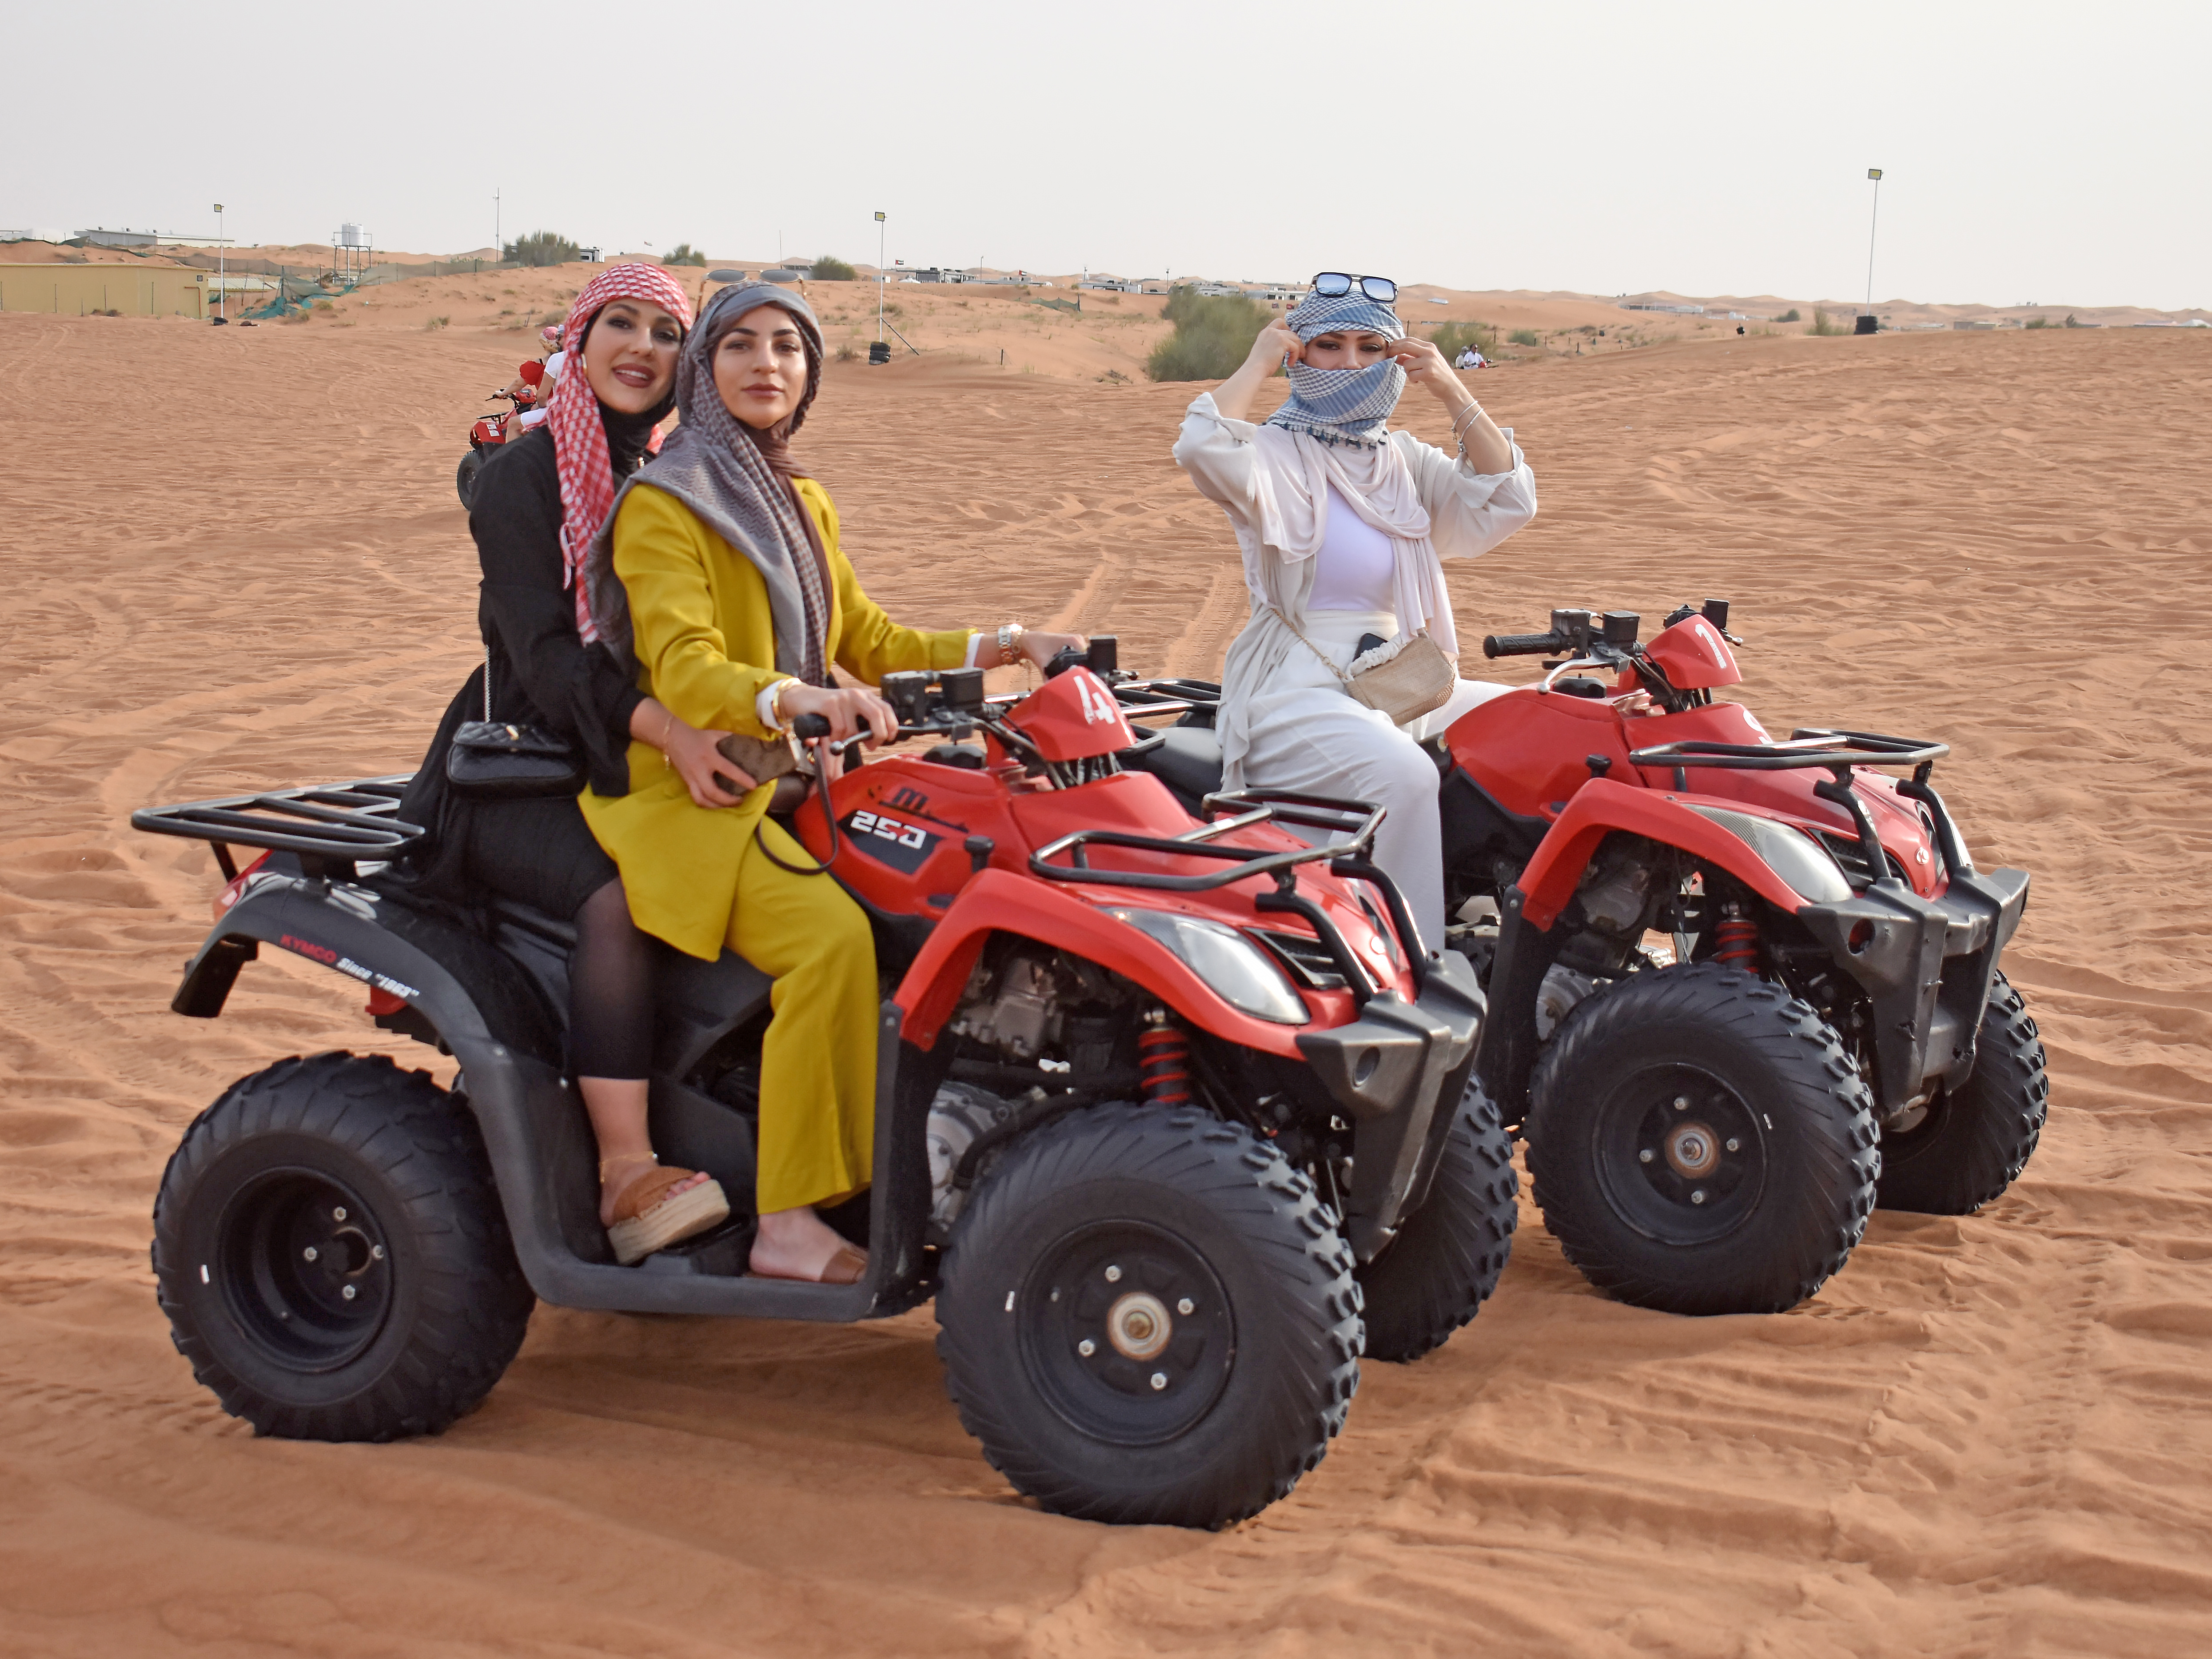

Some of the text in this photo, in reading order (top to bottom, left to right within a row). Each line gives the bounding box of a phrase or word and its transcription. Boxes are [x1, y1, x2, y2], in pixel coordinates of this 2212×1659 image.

[850, 810, 927, 849] 250
[280, 933, 338, 963] KYMCO
[336, 957, 374, 980] Since
